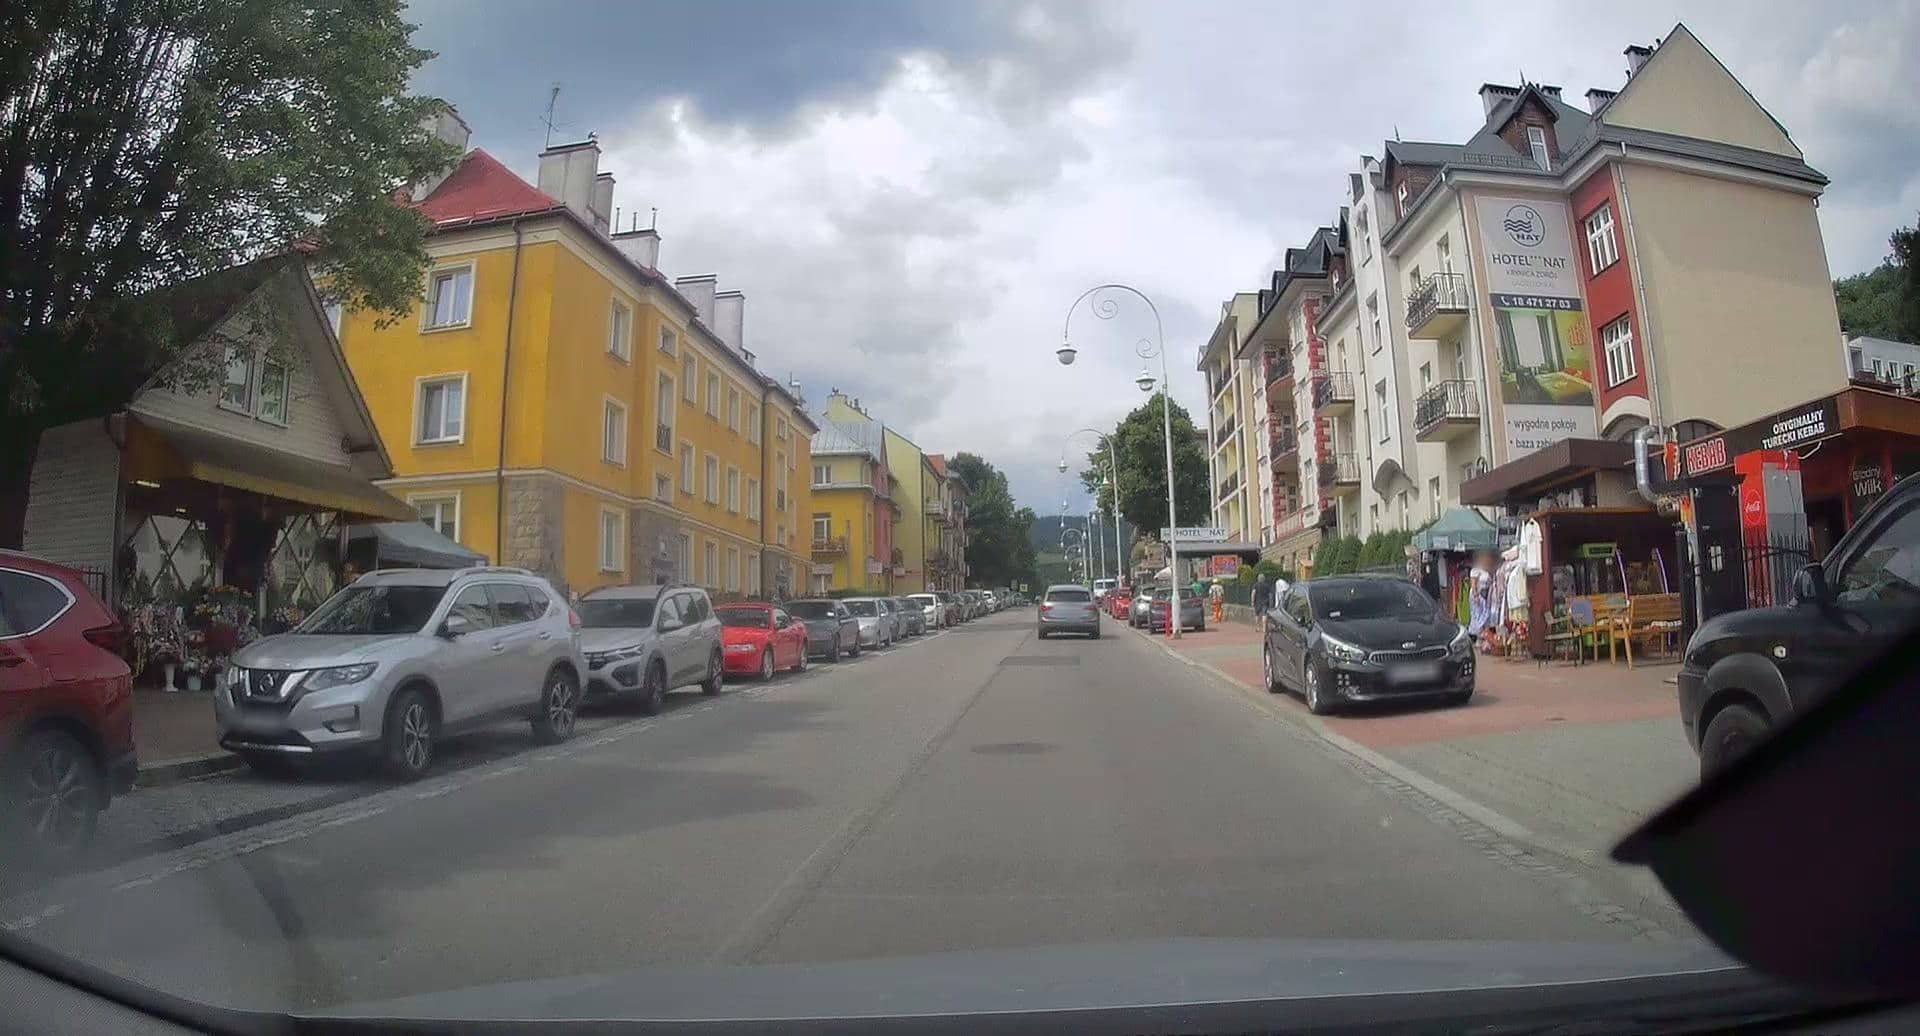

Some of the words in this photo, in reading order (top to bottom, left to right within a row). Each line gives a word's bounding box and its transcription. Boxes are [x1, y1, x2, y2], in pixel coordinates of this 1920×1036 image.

[1492, 254, 1531, 266] HOTEL
[1543, 257, 1566, 268] NAT
[1526, 298, 1543, 307] 471
[1546, 299, 1557, 307] 27
[1551, 418, 1577, 433] pokoje
[1515, 438, 1535, 448] baza
[1762, 429, 1796, 450] TURECKI
[1796, 422, 1825, 441] KEBAB
[1686, 438, 1726, 475] KEBAB
[1854, 478, 1882, 497] Wilk
[1209, 529, 1225, 537] NAT
